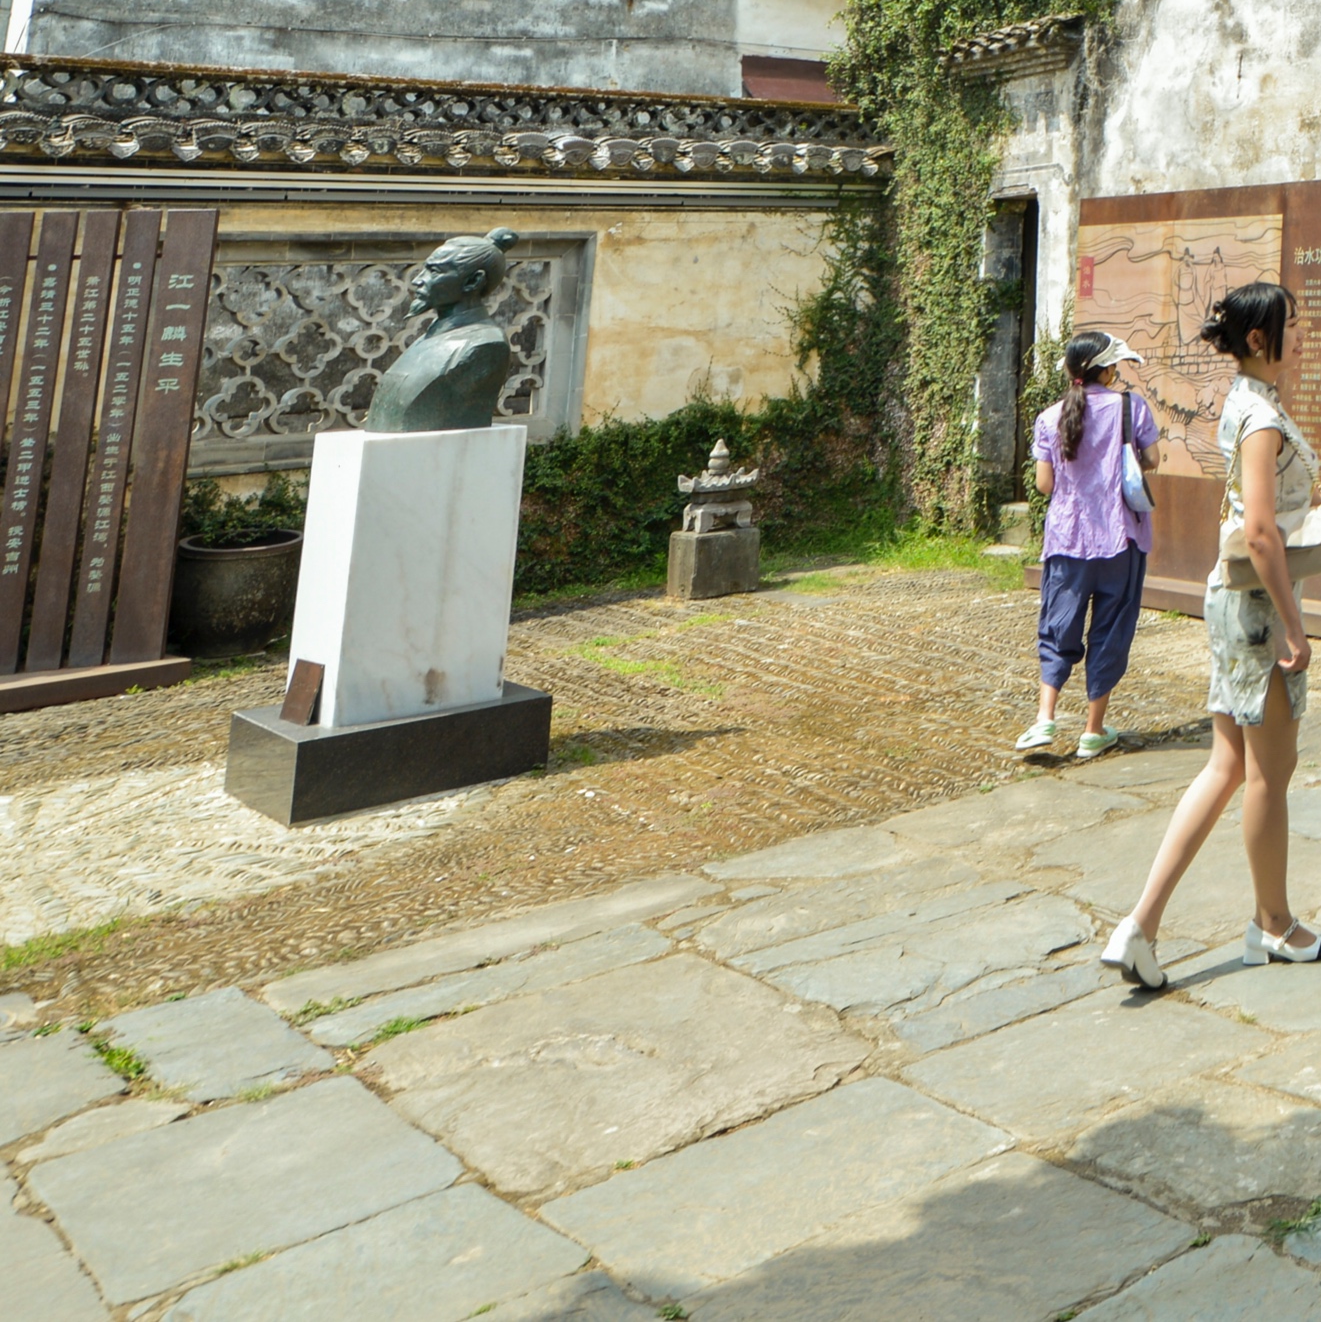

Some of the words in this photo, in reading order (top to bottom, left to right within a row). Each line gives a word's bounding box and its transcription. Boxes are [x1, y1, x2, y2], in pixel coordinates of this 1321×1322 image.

[154, 274, 195, 395] 江一麟生平
